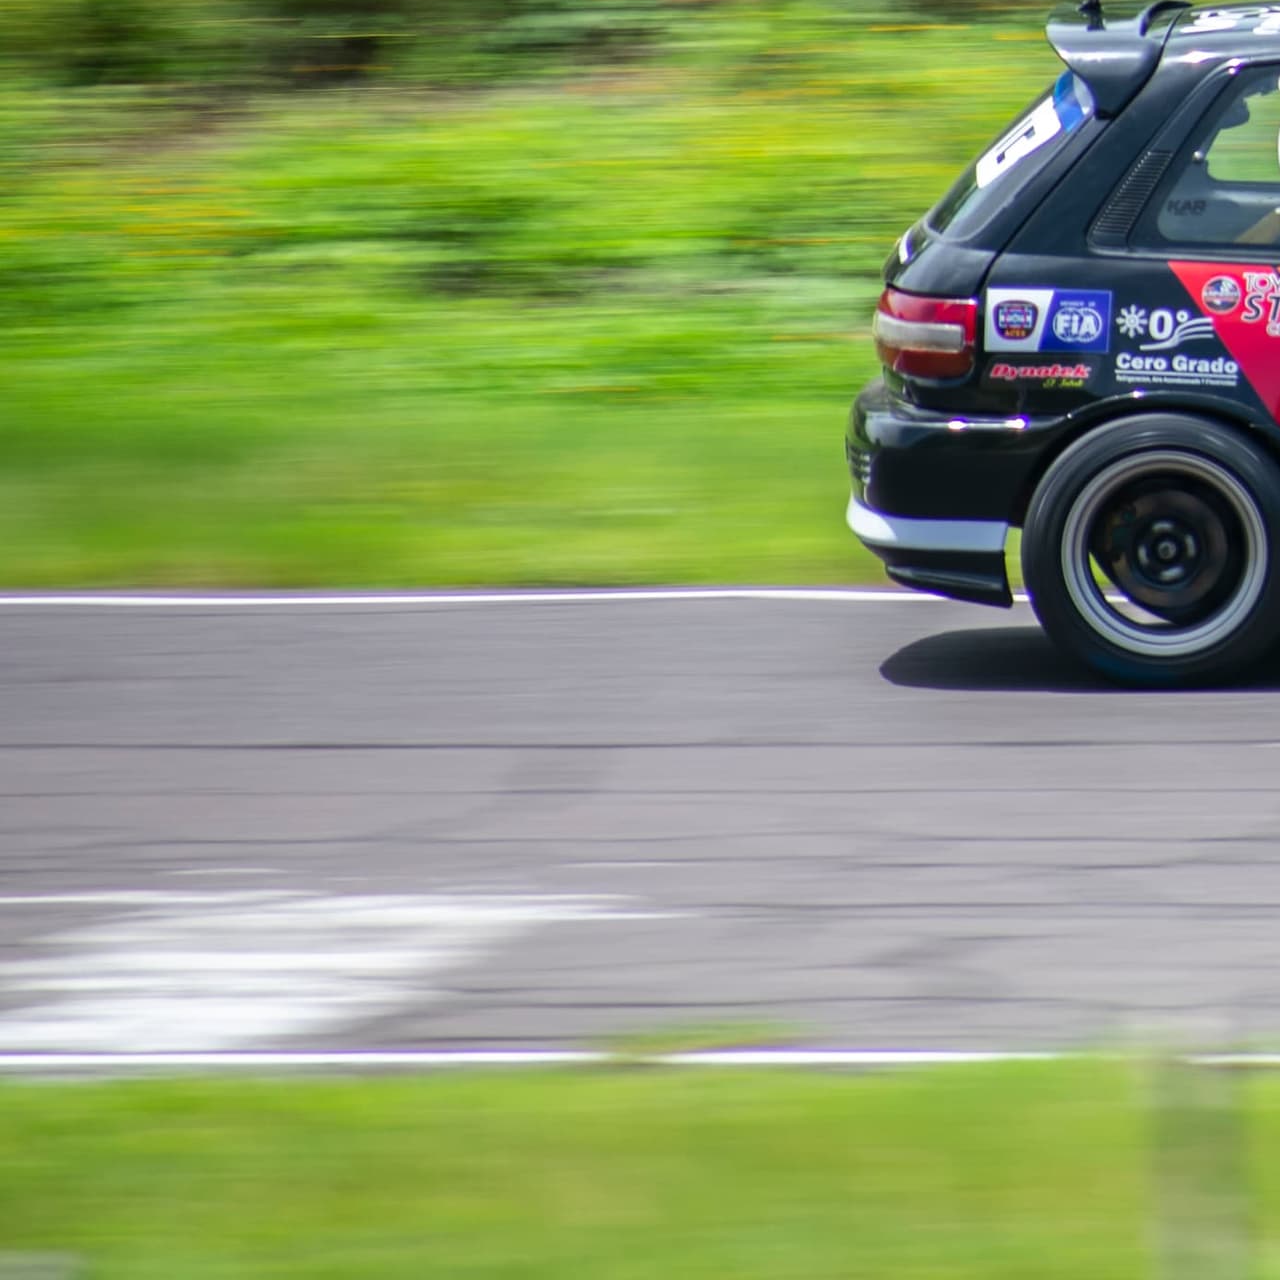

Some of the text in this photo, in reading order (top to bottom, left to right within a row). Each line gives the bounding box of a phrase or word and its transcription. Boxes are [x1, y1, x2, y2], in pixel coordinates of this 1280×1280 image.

[1056, 313, 1097, 337] FIA
[990, 363, 1090, 380] Dynotek
[1116, 352, 1238, 374] Cero Grado
